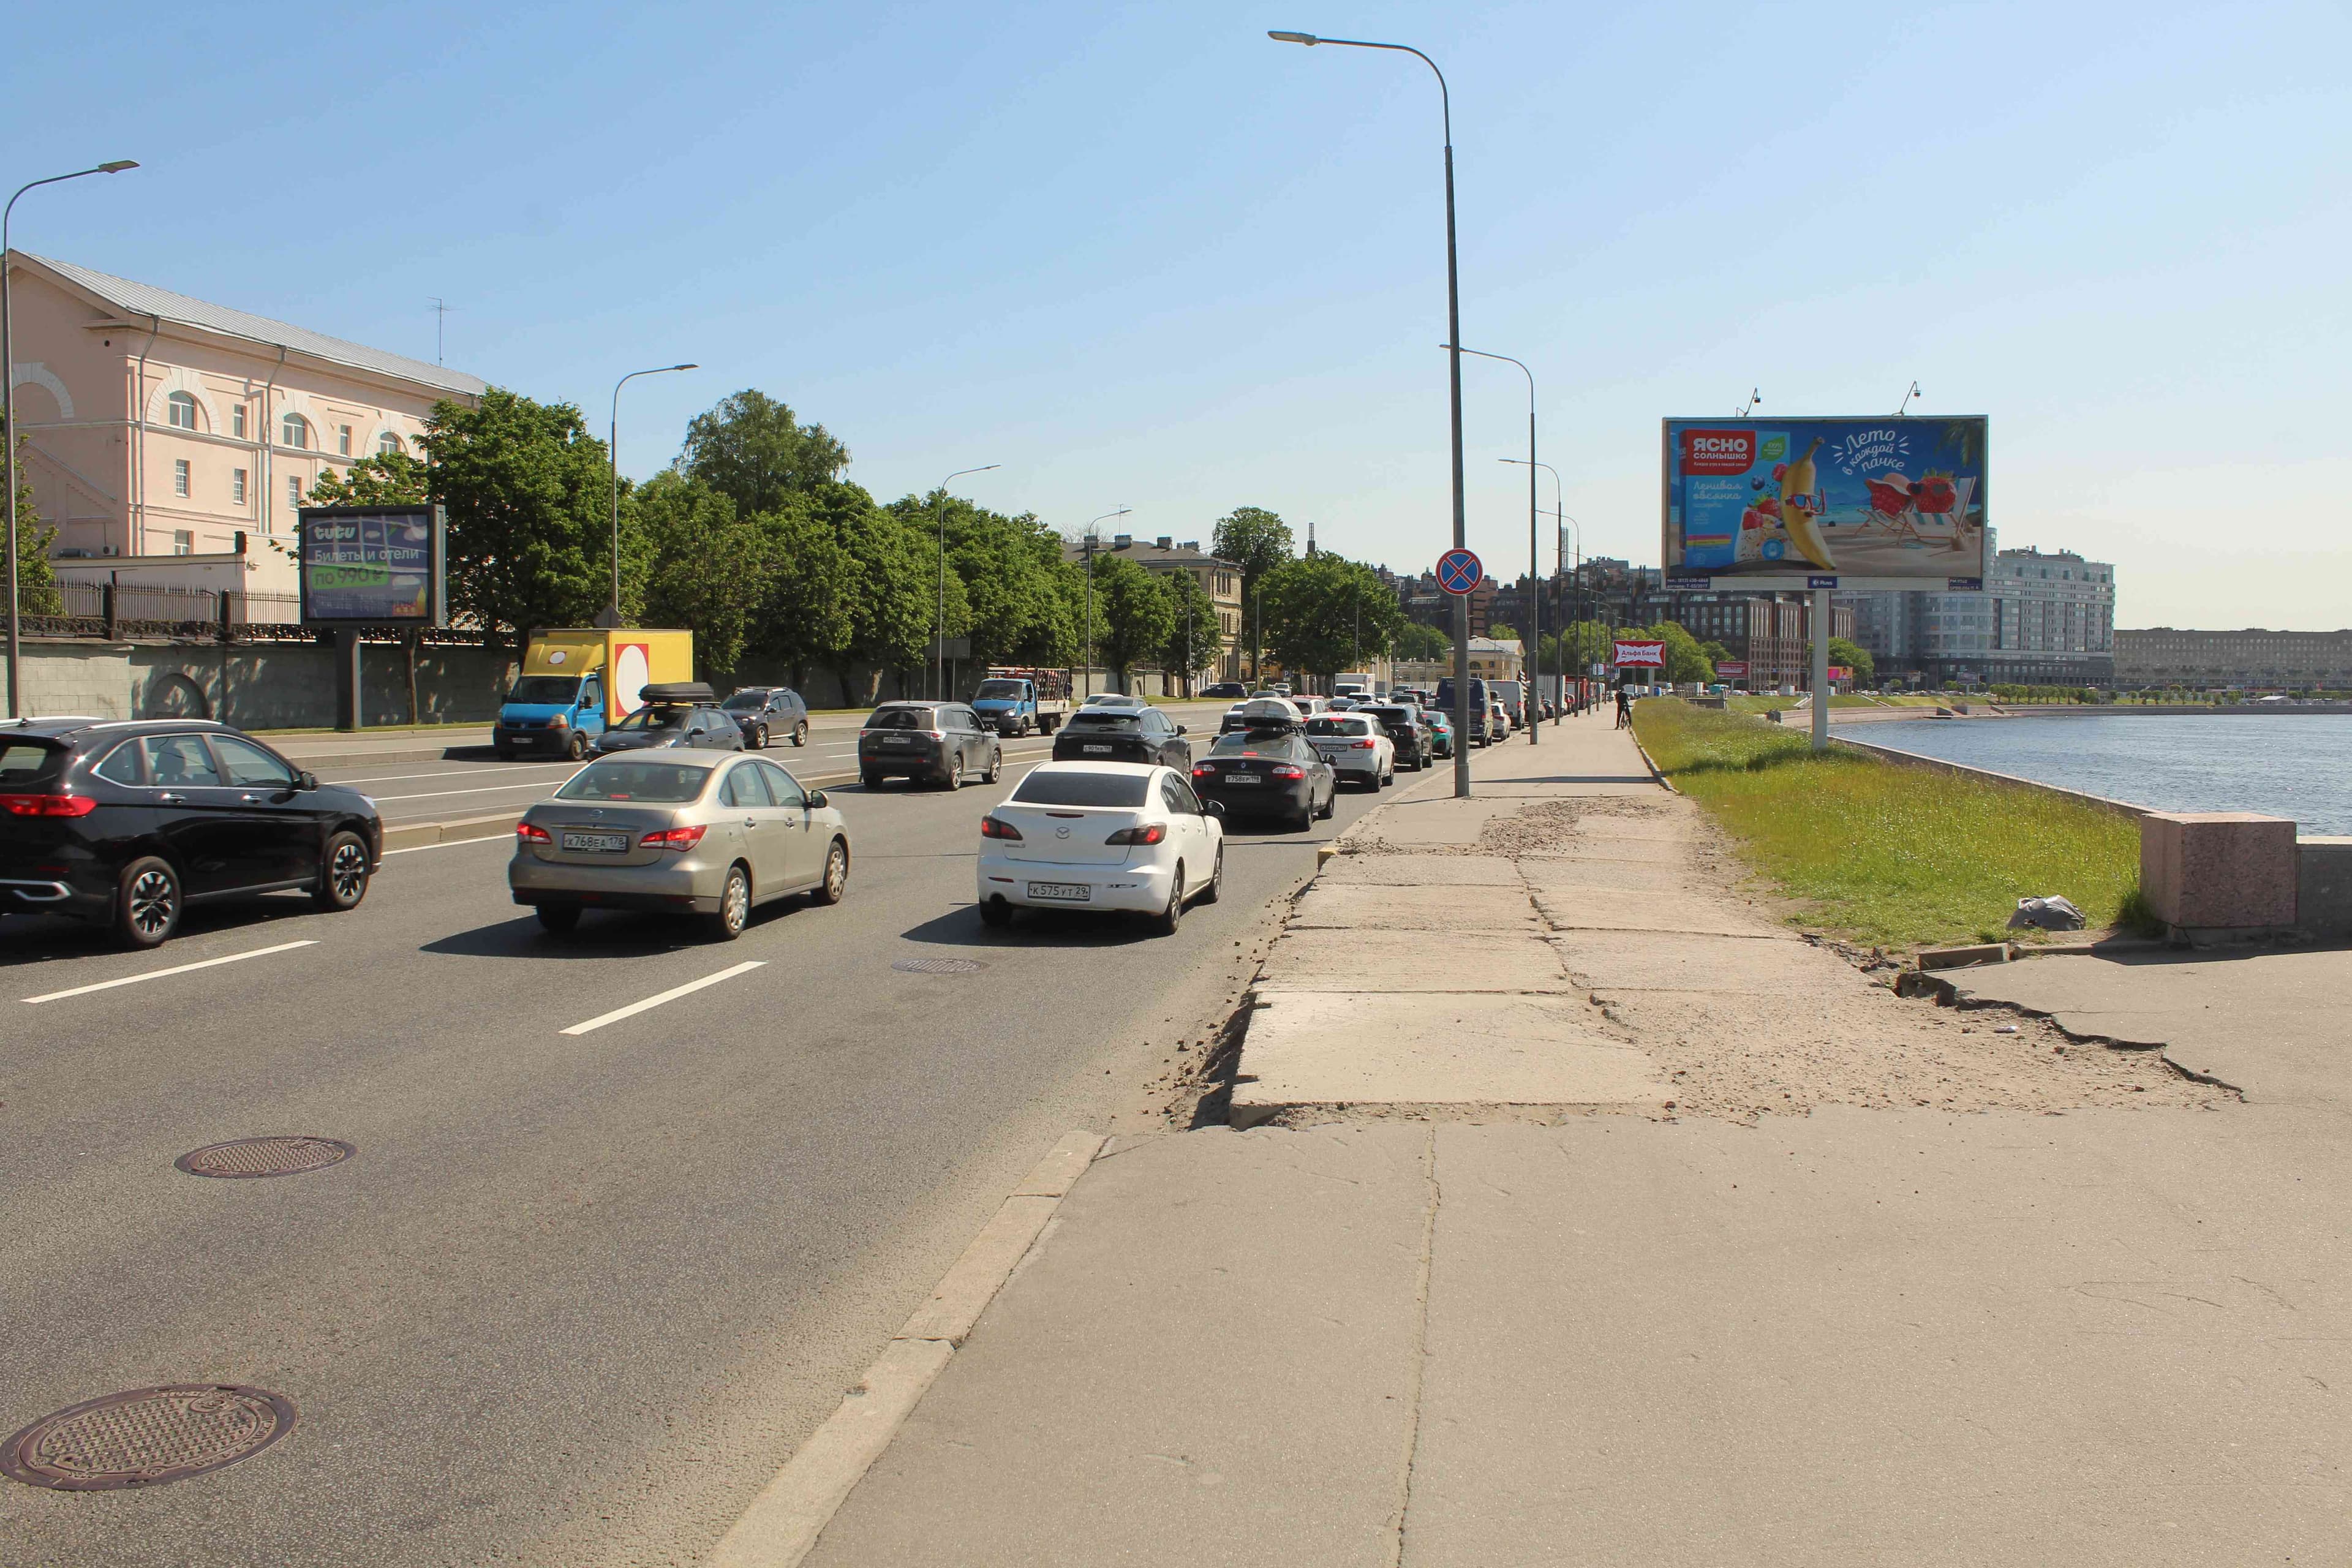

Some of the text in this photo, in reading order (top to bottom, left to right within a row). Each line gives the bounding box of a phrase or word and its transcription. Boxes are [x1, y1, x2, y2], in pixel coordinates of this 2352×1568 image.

[1693, 438, 1748, 452] ЯСНО
[1846, 429, 1896, 454] Лето
[1842, 443, 1895, 475] в каждой
[1861, 457, 1905, 473] пачке
[1693, 480, 1743, 490] Ленивая
[314, 526, 356, 540] tutu
[314, 549, 419, 562] Билеты и отели
[315, 572, 334, 586] по
[337, 568, 369, 583] 990
